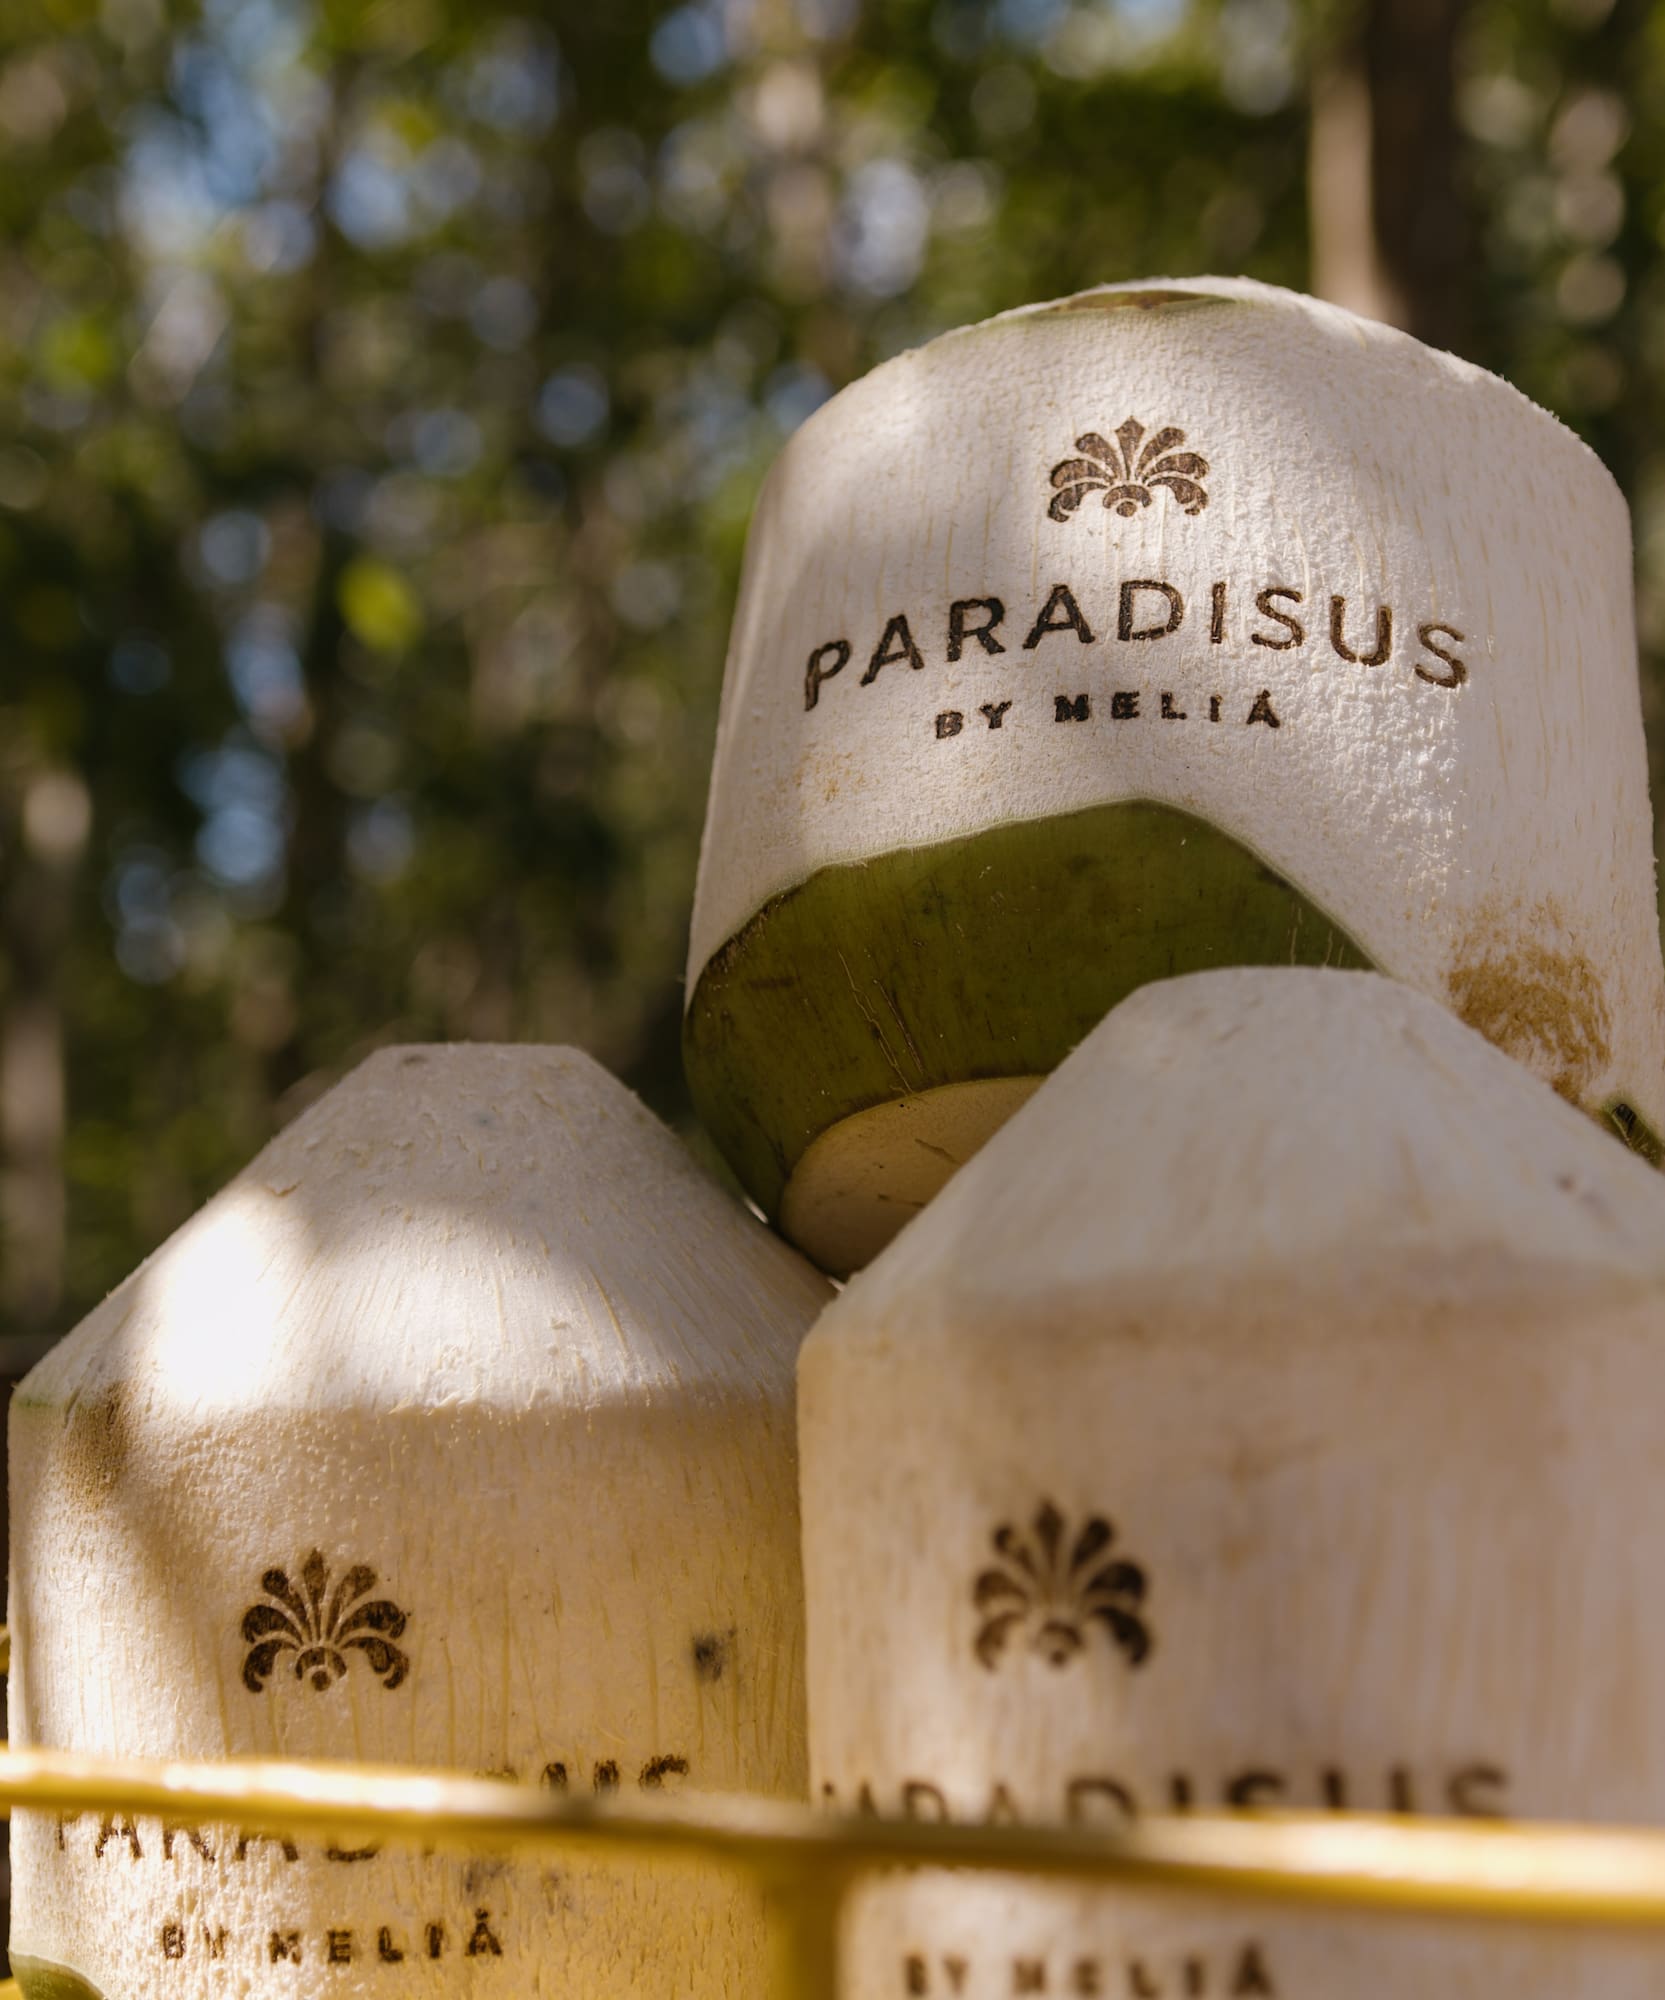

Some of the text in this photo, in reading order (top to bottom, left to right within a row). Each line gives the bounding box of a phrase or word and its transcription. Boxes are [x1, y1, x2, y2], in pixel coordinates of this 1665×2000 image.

[804, 579, 1469, 712] PARADISUS
[935, 692, 1012, 739] BY
[162, 1924, 230, 1960] BY
